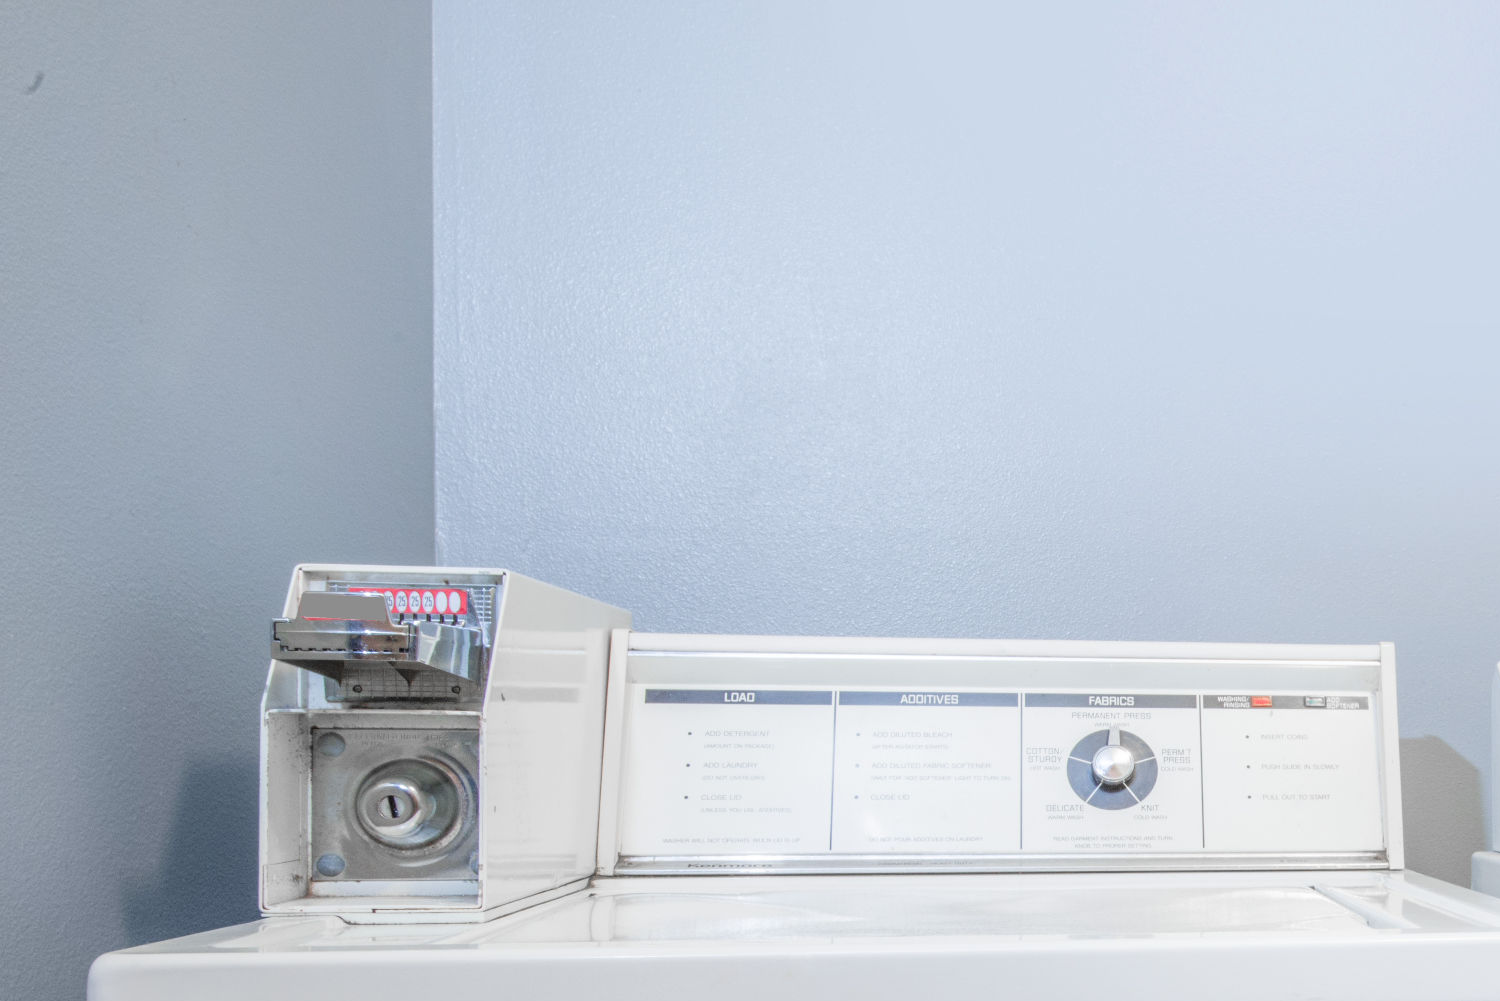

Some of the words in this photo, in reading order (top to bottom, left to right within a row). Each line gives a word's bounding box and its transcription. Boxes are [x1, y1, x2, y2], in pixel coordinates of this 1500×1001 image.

[398, 595, 406, 607] 25
[411, 595, 419, 607] 25
[424, 595, 433, 607] 25
[724, 692, 756, 703] LOAD
[900, 694, 959, 705] ADDITIVES
[1088, 696, 1135, 707] FABRICS
[1071, 712, 1120, 720] PERMANENT
[1124, 712, 1152, 720] PRESS
[705, 729, 720, 737] ADD
[723, 729, 770, 737] DETERGENT
[872, 731, 888, 739] ADD
[890, 731, 921, 739] DILUTED
[923, 731, 953, 739] BLEACH
[1027, 755, 1062, 763] STURDY
[1163, 756, 1191, 764] PRESS
[703, 761, 720, 769] ADD
[722, 761, 758, 769] LAUNDRY
[1046, 804, 1084, 812] DELICATE
[1141, 804, 1160, 812] KNIT
